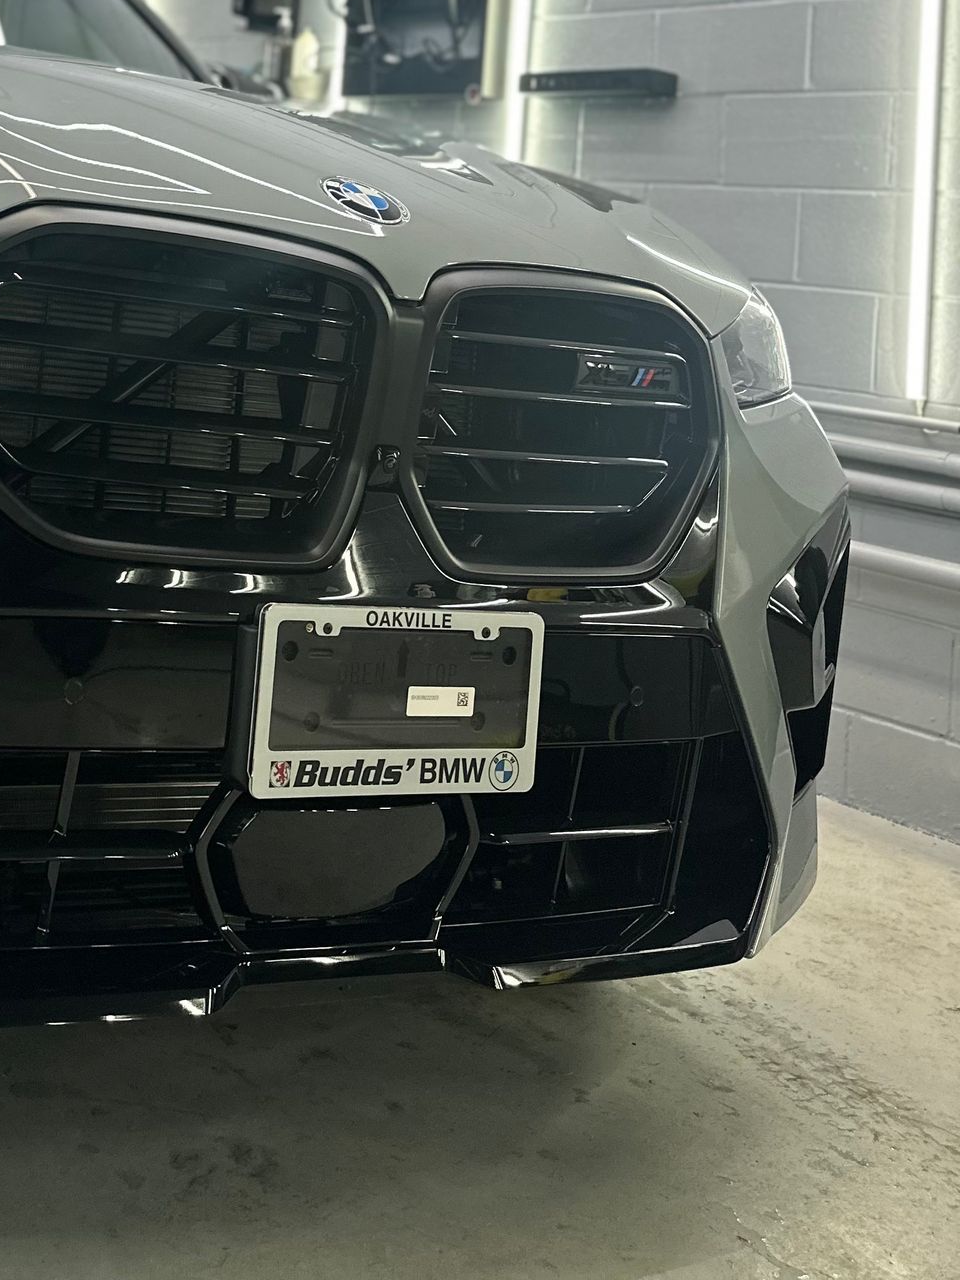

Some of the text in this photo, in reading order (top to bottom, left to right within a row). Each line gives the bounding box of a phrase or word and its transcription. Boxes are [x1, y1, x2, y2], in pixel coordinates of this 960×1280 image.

[366, 610, 452, 629] OAKVILLE
[424, 662, 458, 684] TOP
[292, 757, 487, 788] Budds' BMW
